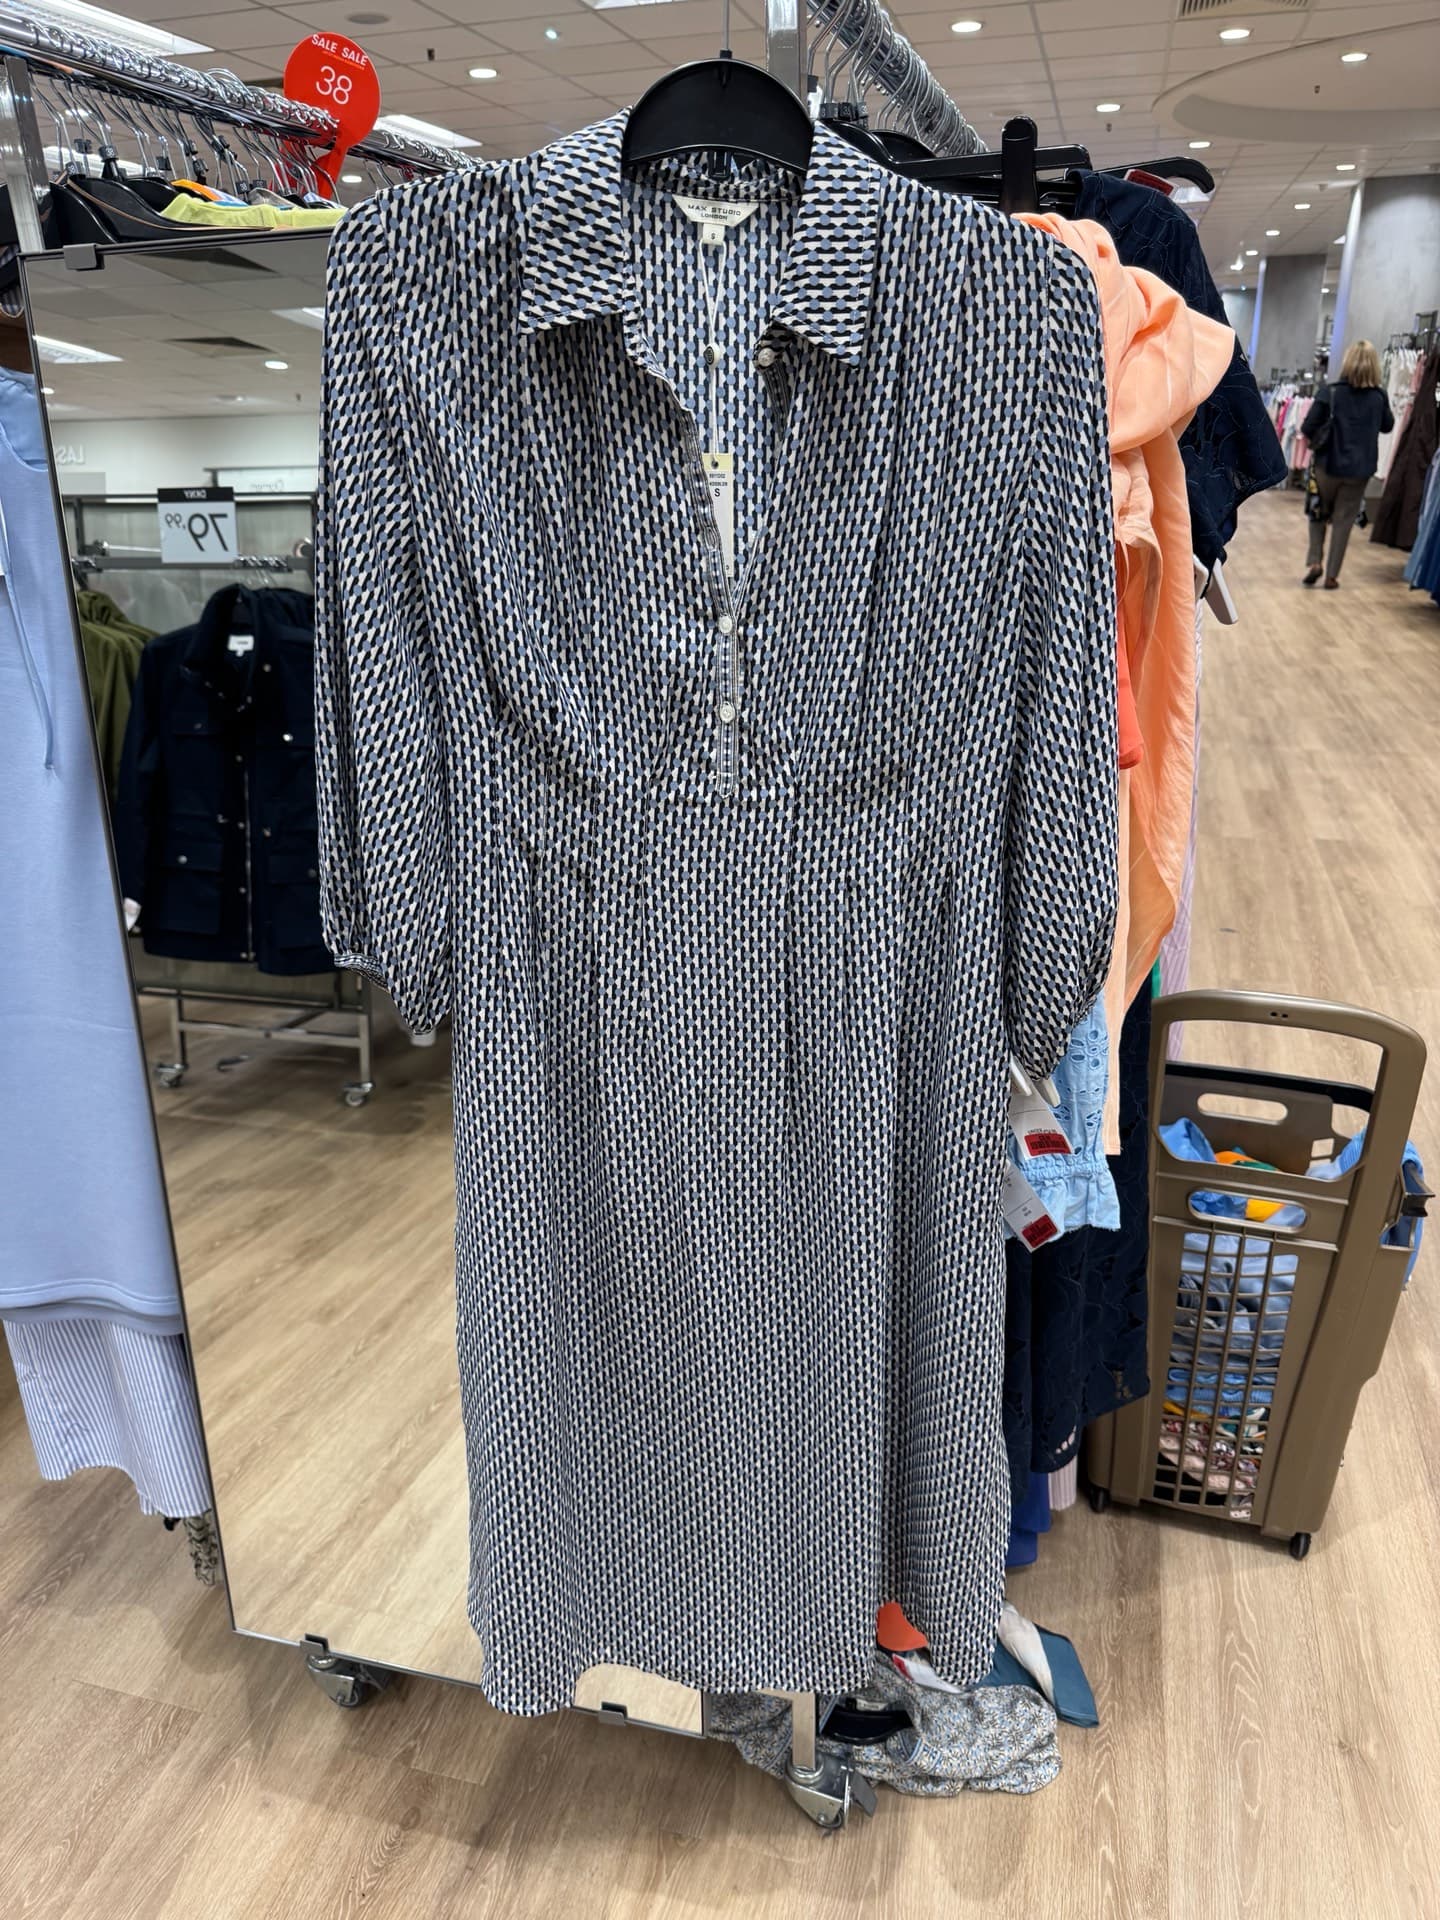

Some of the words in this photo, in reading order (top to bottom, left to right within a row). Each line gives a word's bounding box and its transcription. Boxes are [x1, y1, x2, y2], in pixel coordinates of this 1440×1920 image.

[312, 34, 338, 53] SALE
[341, 47, 369, 66] SALE
[315, 65, 353, 105] 38
[711, 207, 742, 216] STUDIO
[714, 488, 721, 497] S
